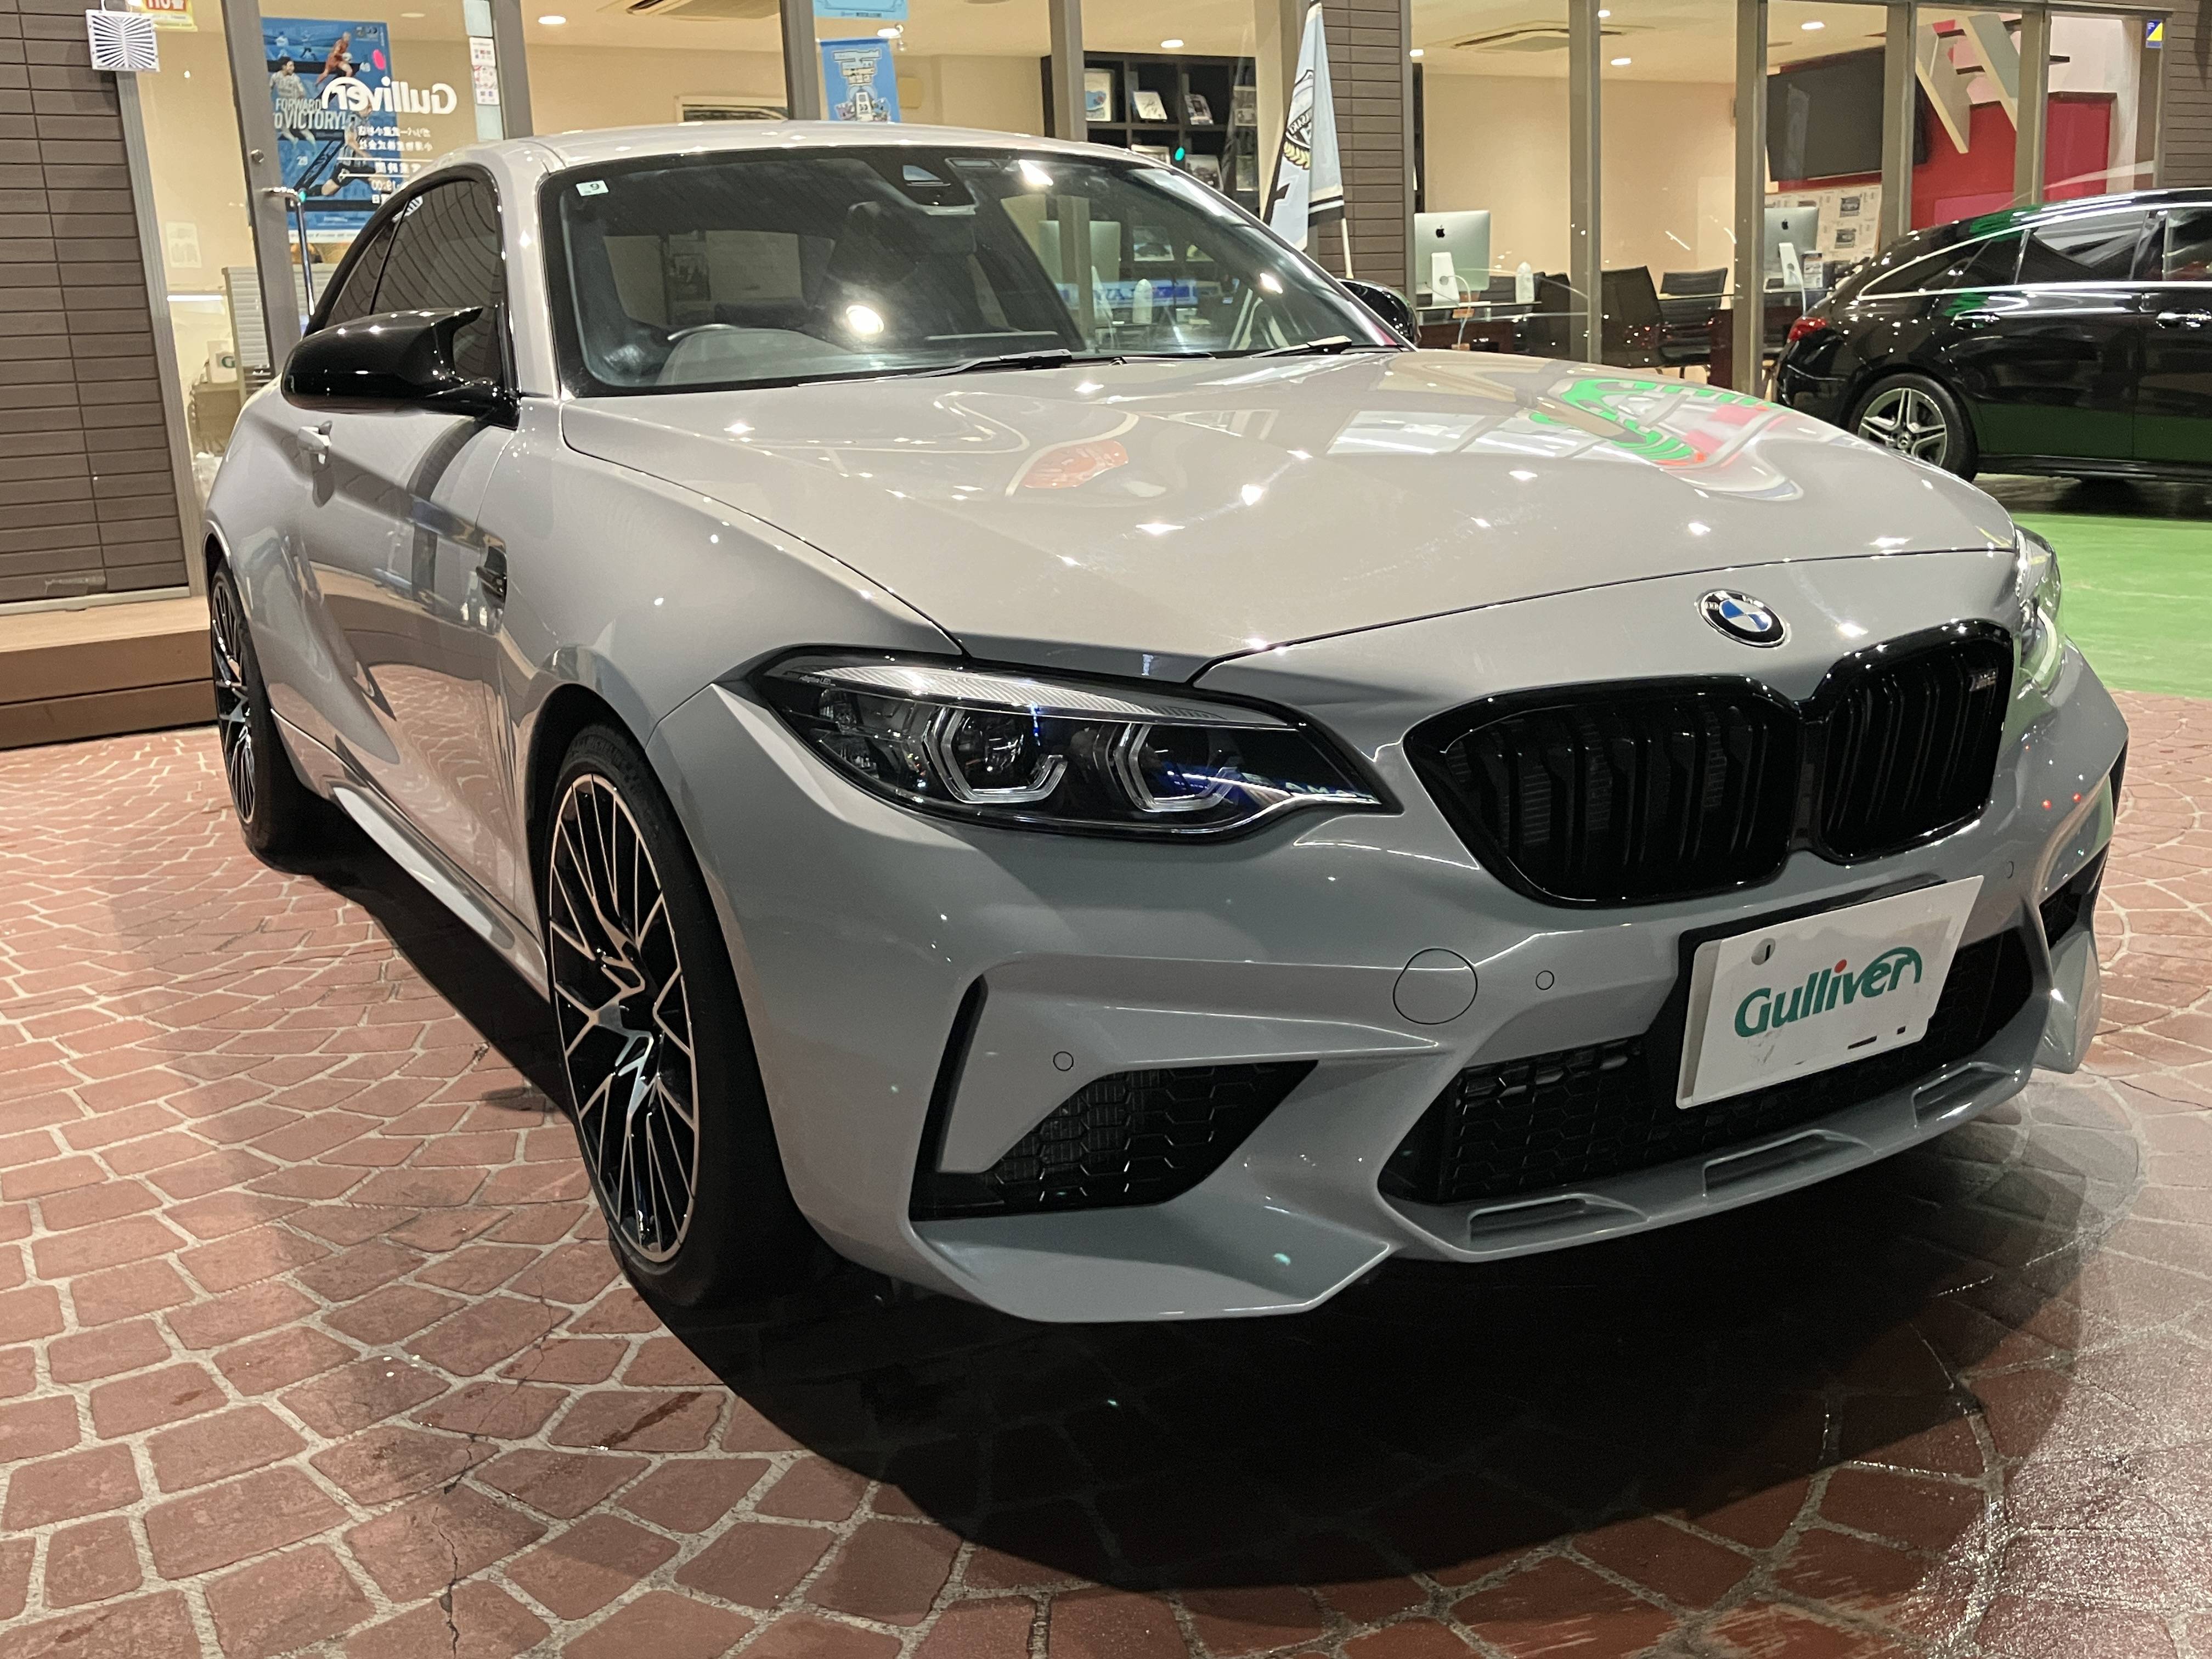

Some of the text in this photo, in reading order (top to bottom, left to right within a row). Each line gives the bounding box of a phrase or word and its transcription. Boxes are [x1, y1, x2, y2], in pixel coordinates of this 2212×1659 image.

[275, 98, 322, 113] FORWARD
[283, 110, 347, 130] VICTORY!
[1734, 946, 1922, 1037] Gulliver
